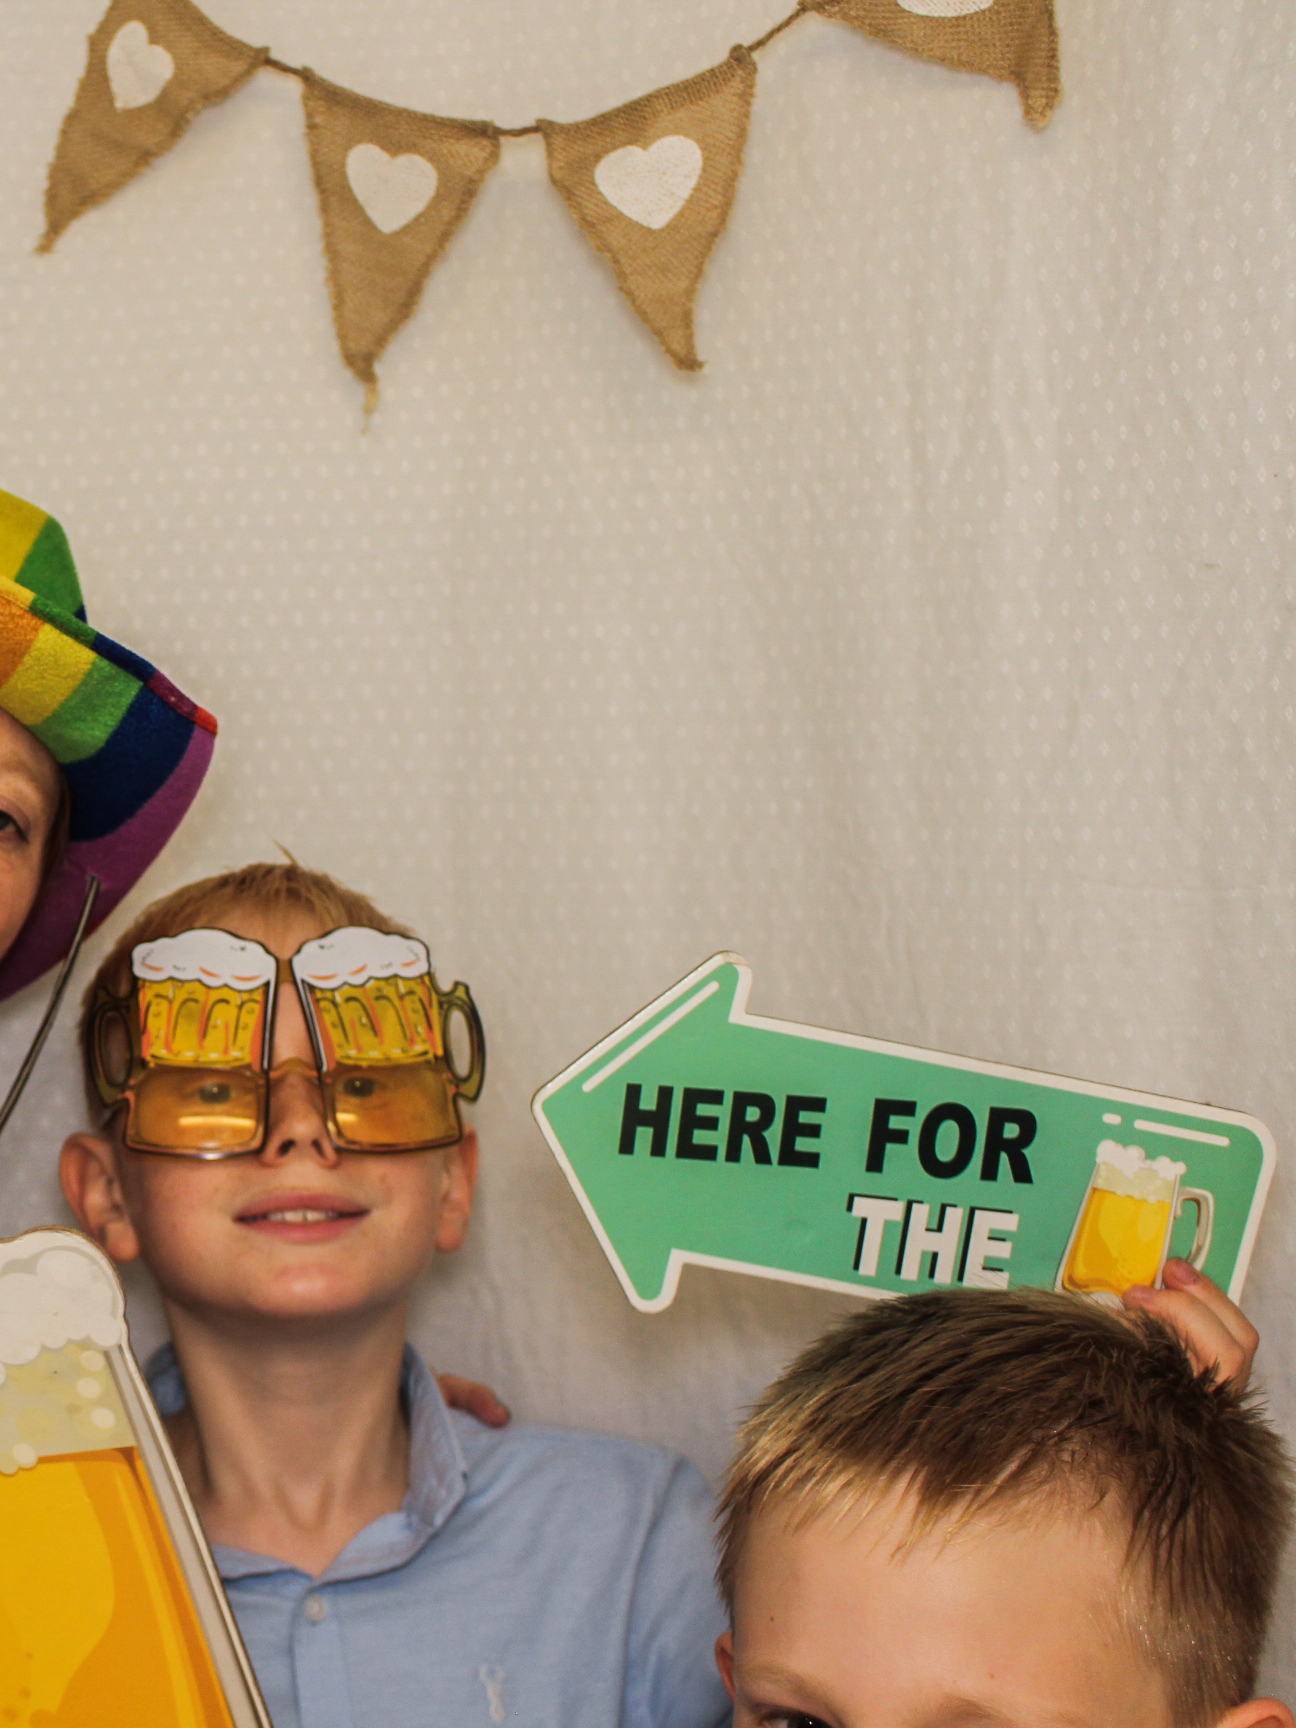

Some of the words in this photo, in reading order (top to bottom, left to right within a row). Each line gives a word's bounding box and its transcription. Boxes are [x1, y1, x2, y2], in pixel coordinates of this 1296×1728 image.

[618, 1083, 827, 1169] HERE
[866, 1098, 1038, 1184] FOR
[847, 1193, 1019, 1288] THE
